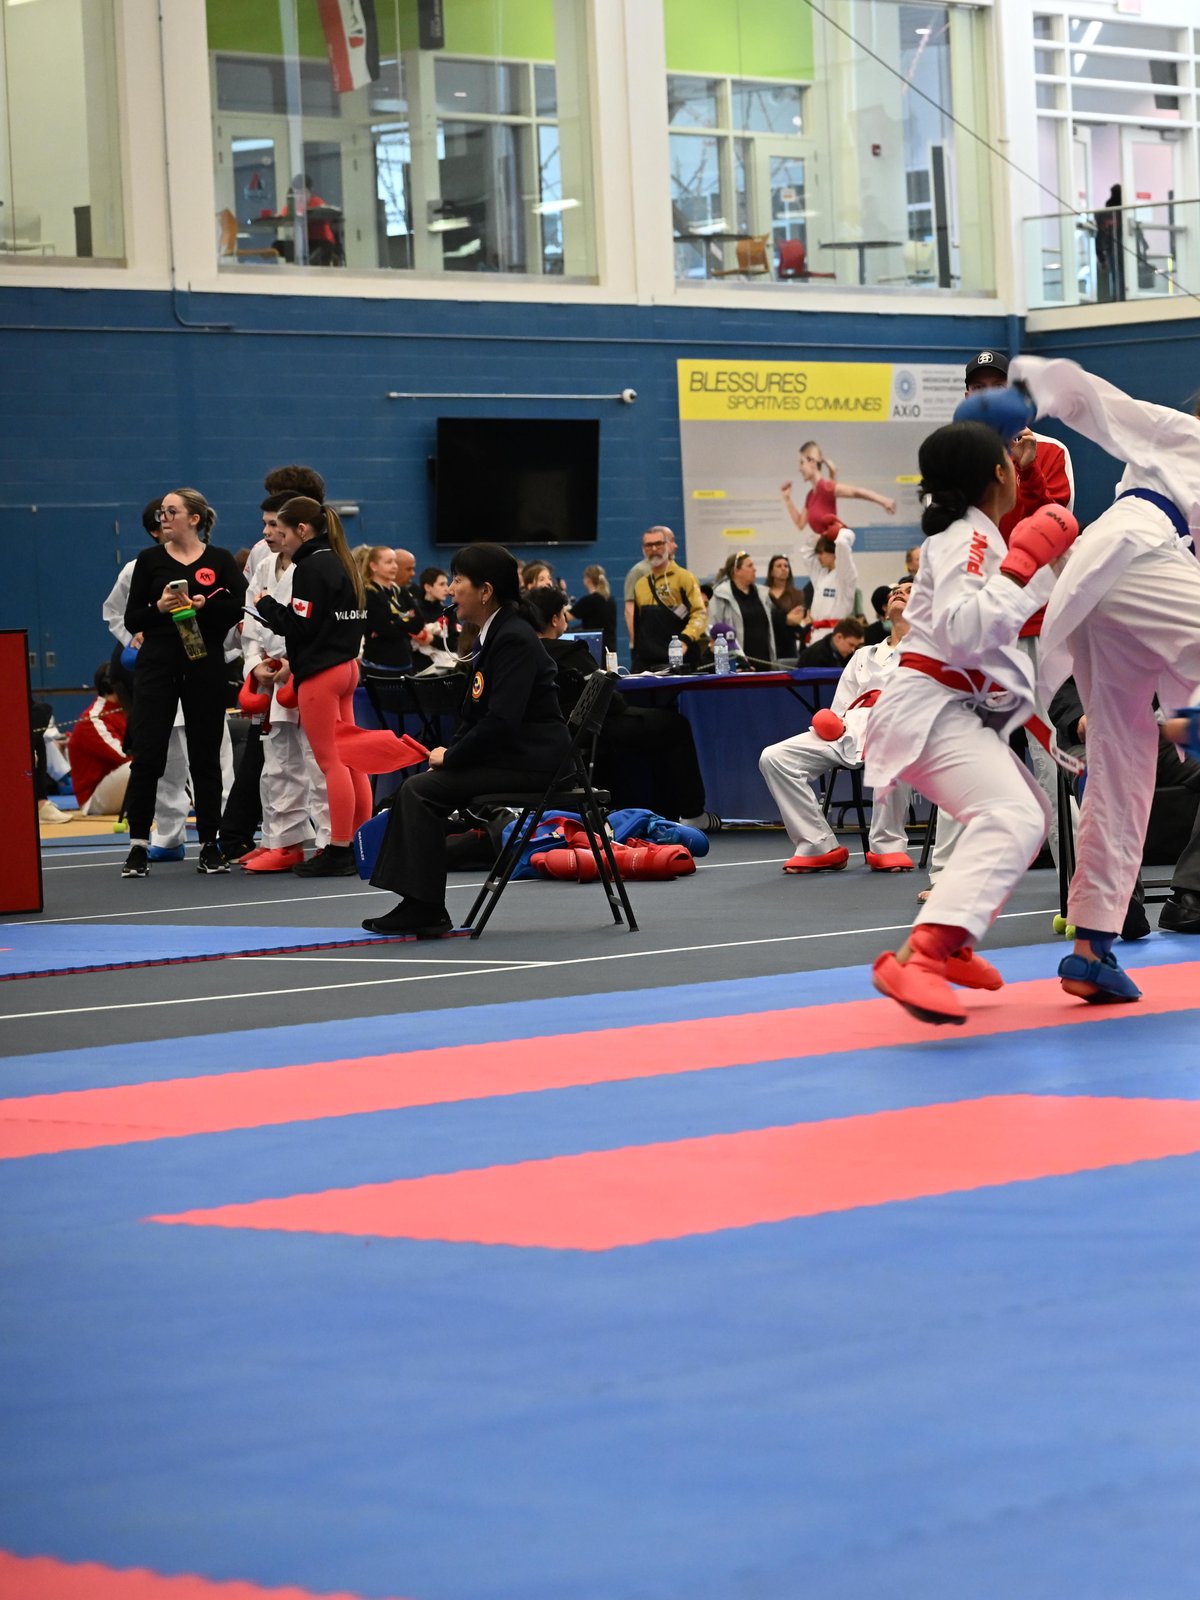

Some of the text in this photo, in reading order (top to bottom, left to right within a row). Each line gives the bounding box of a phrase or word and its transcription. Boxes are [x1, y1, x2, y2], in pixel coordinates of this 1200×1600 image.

[689, 371, 807, 393] BLESSURES
[727, 395, 882, 411] SPORTIVES COMMUNES
